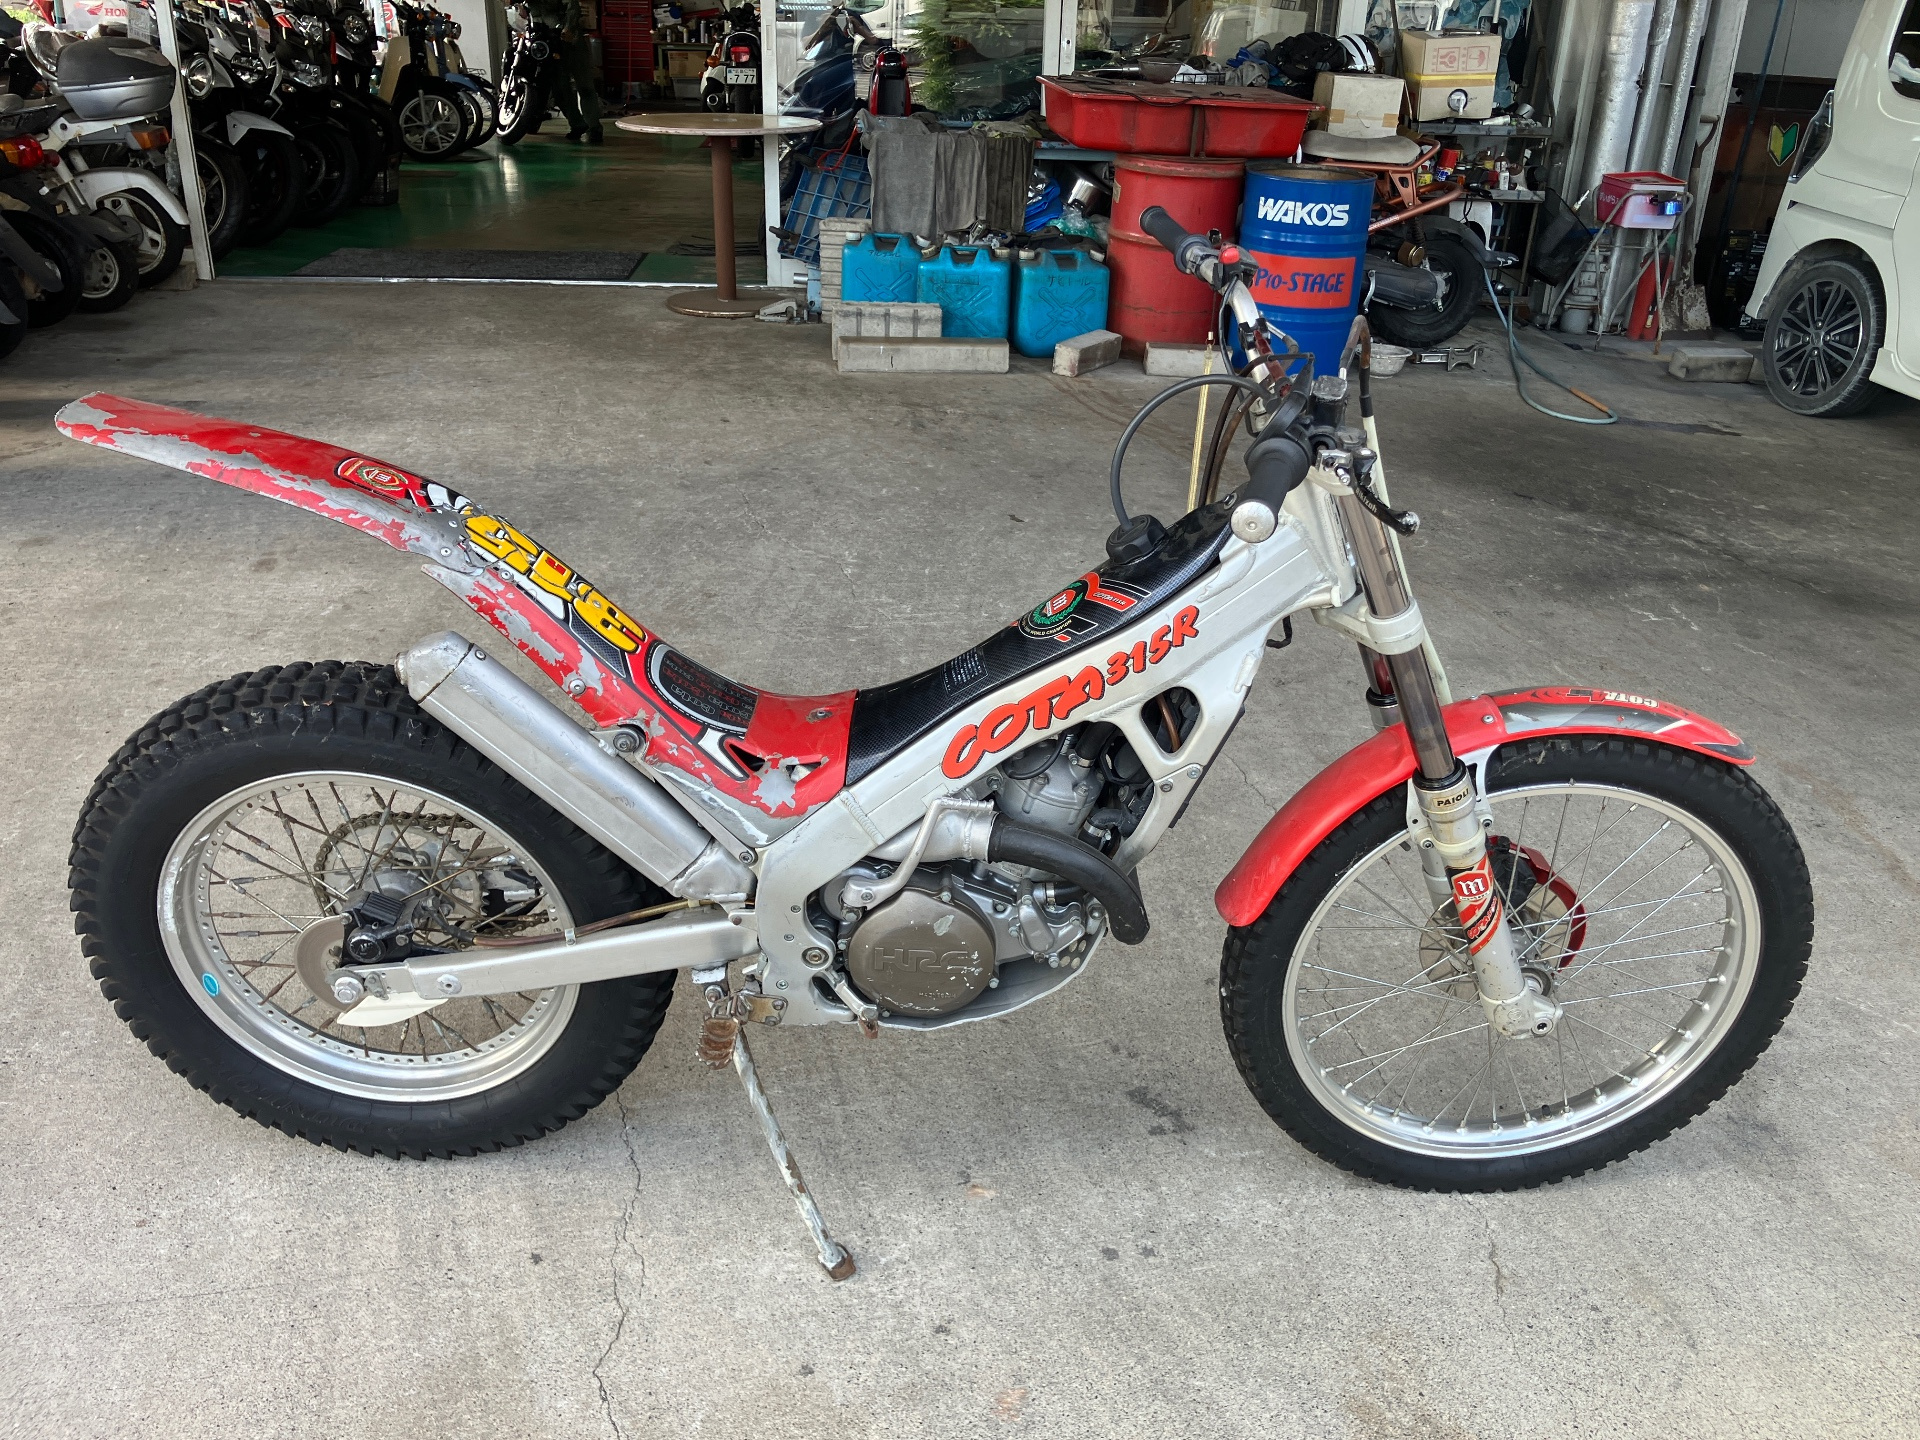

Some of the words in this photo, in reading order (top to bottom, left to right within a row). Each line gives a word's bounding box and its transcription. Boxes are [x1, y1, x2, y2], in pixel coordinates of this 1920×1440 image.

[103, 8, 128, 17] HON
[1258, 196, 1349, 227] WAKO'S
[941, 665, 1106, 779] COTA
[1106, 605, 1200, 686] 315R
[1436, 788, 1470, 807] PAIOLI
